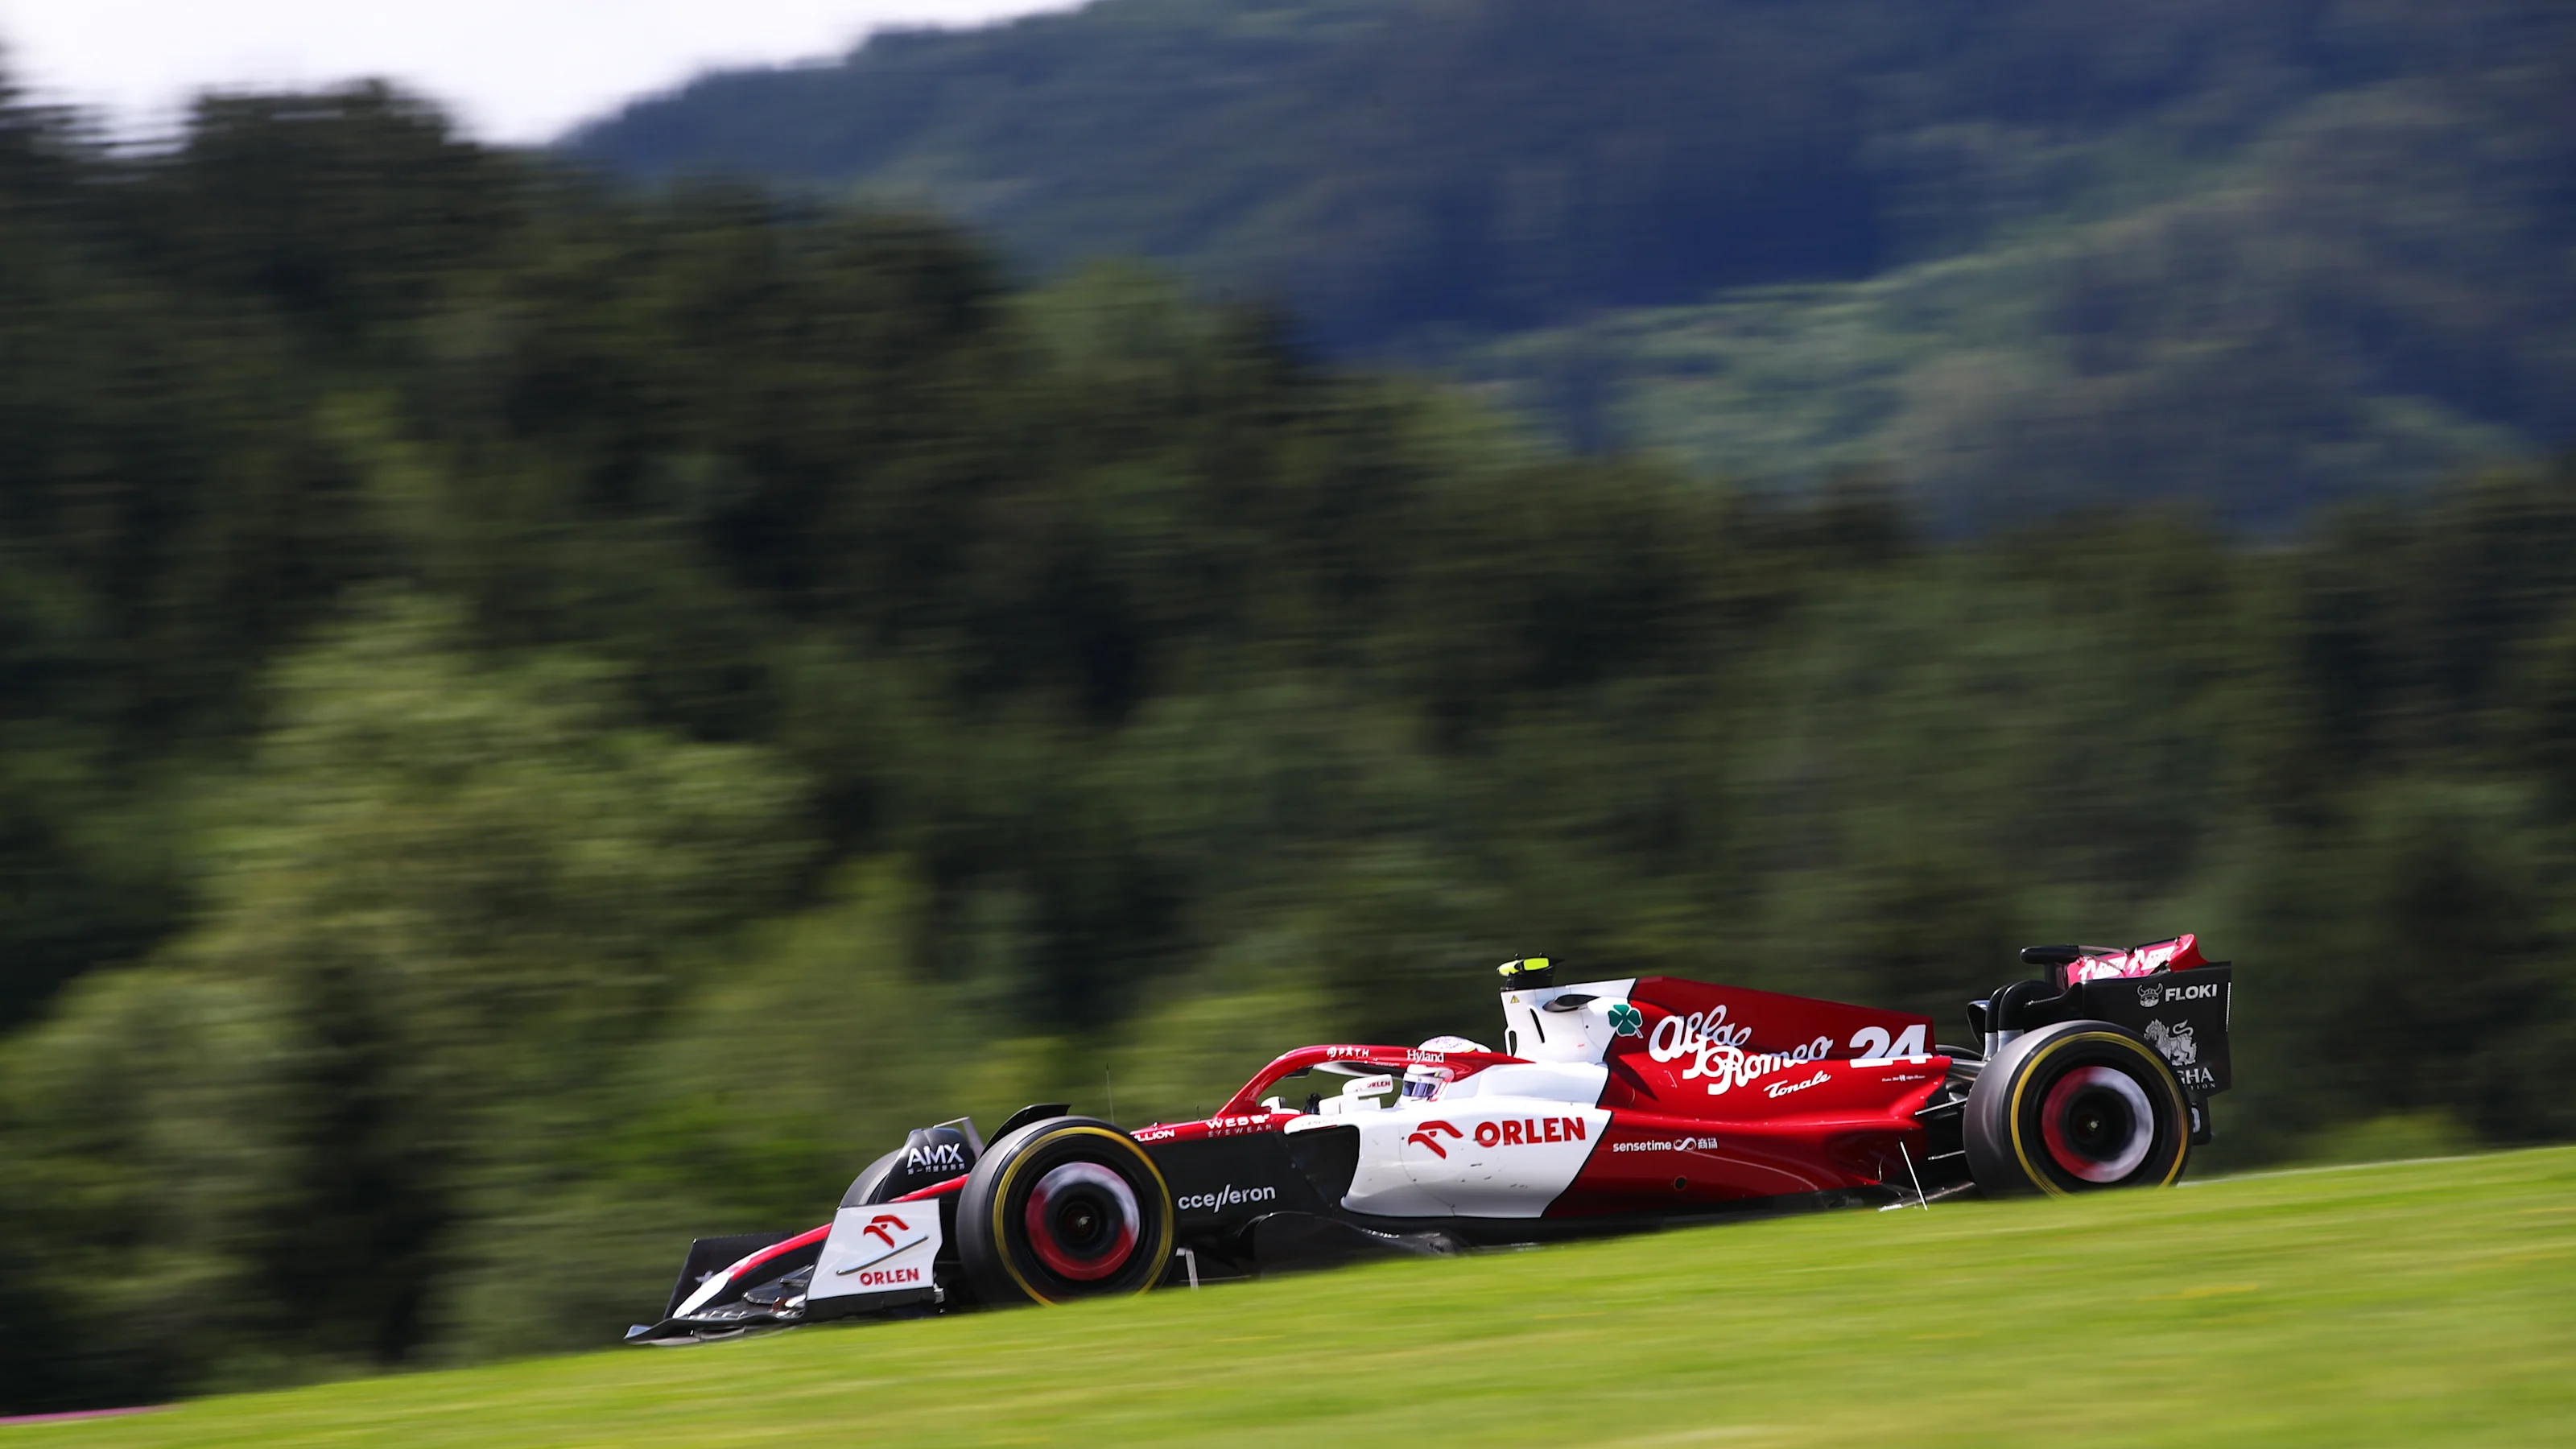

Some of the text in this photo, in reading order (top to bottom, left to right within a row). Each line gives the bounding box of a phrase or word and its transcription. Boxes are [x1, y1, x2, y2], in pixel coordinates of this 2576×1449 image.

[2165, 984, 2218, 1002] FLOKI
[1406, 1049, 1444, 1063] Hyland
[1649, 1005, 1752, 1080] Alfa
[1849, 1024, 1933, 1068] 24
[1705, 1035, 1834, 1096] Romeo
[1763, 1070, 1831, 1099] Tonale
[1475, 1117, 1586, 1149] ORLEN
[1612, 1139, 1672, 1152] sensetime
[906, 1142, 964, 1168] AMX
[860, 1268, 919, 1286] ORLEN
